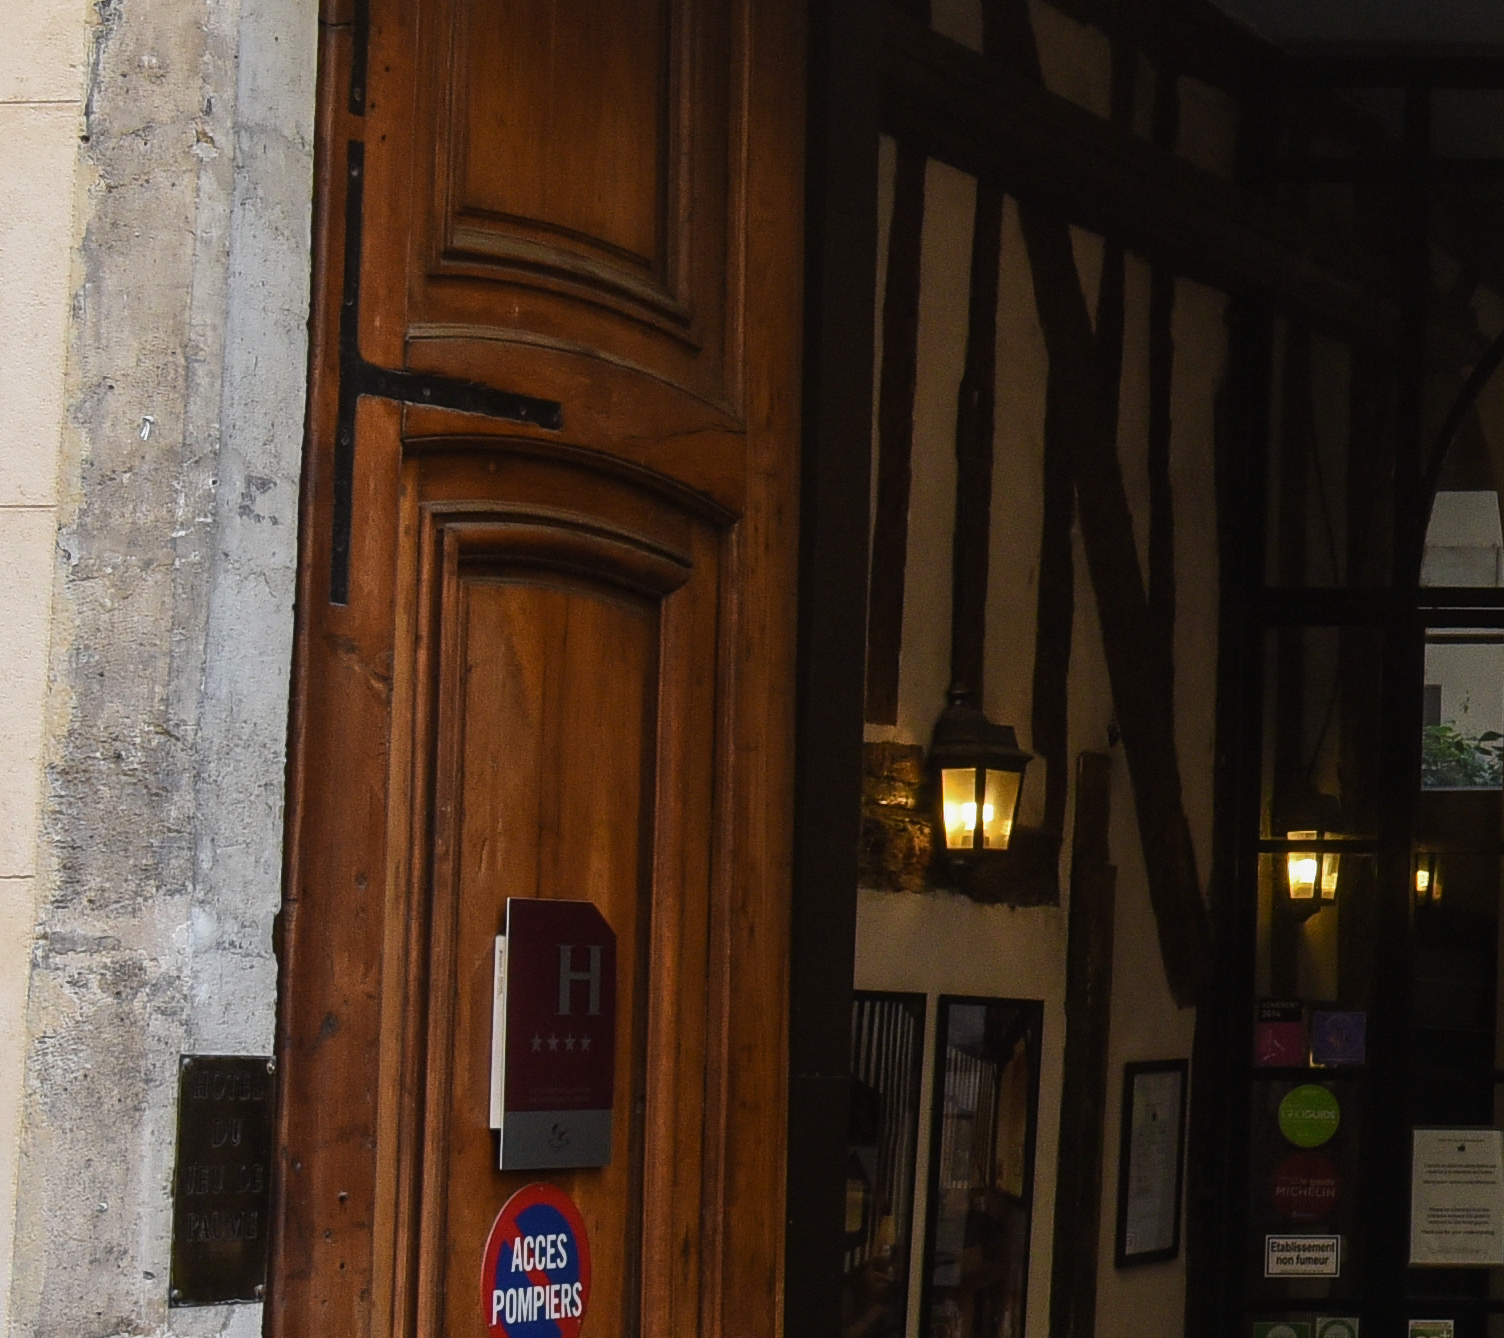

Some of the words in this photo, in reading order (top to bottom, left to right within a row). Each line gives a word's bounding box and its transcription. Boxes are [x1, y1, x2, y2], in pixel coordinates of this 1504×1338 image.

[555, 944, 605, 1016] H
[1276, 1186, 1336, 1198] MICHELIN
[510, 1233, 568, 1274] ACCES
[1270, 1241, 1336, 1253] Etablissement
[1275, 1256, 1294, 1266] non
[1295, 1254, 1330, 1266] fumeur
[491, 1280, 583, 1327] POMPIERS
